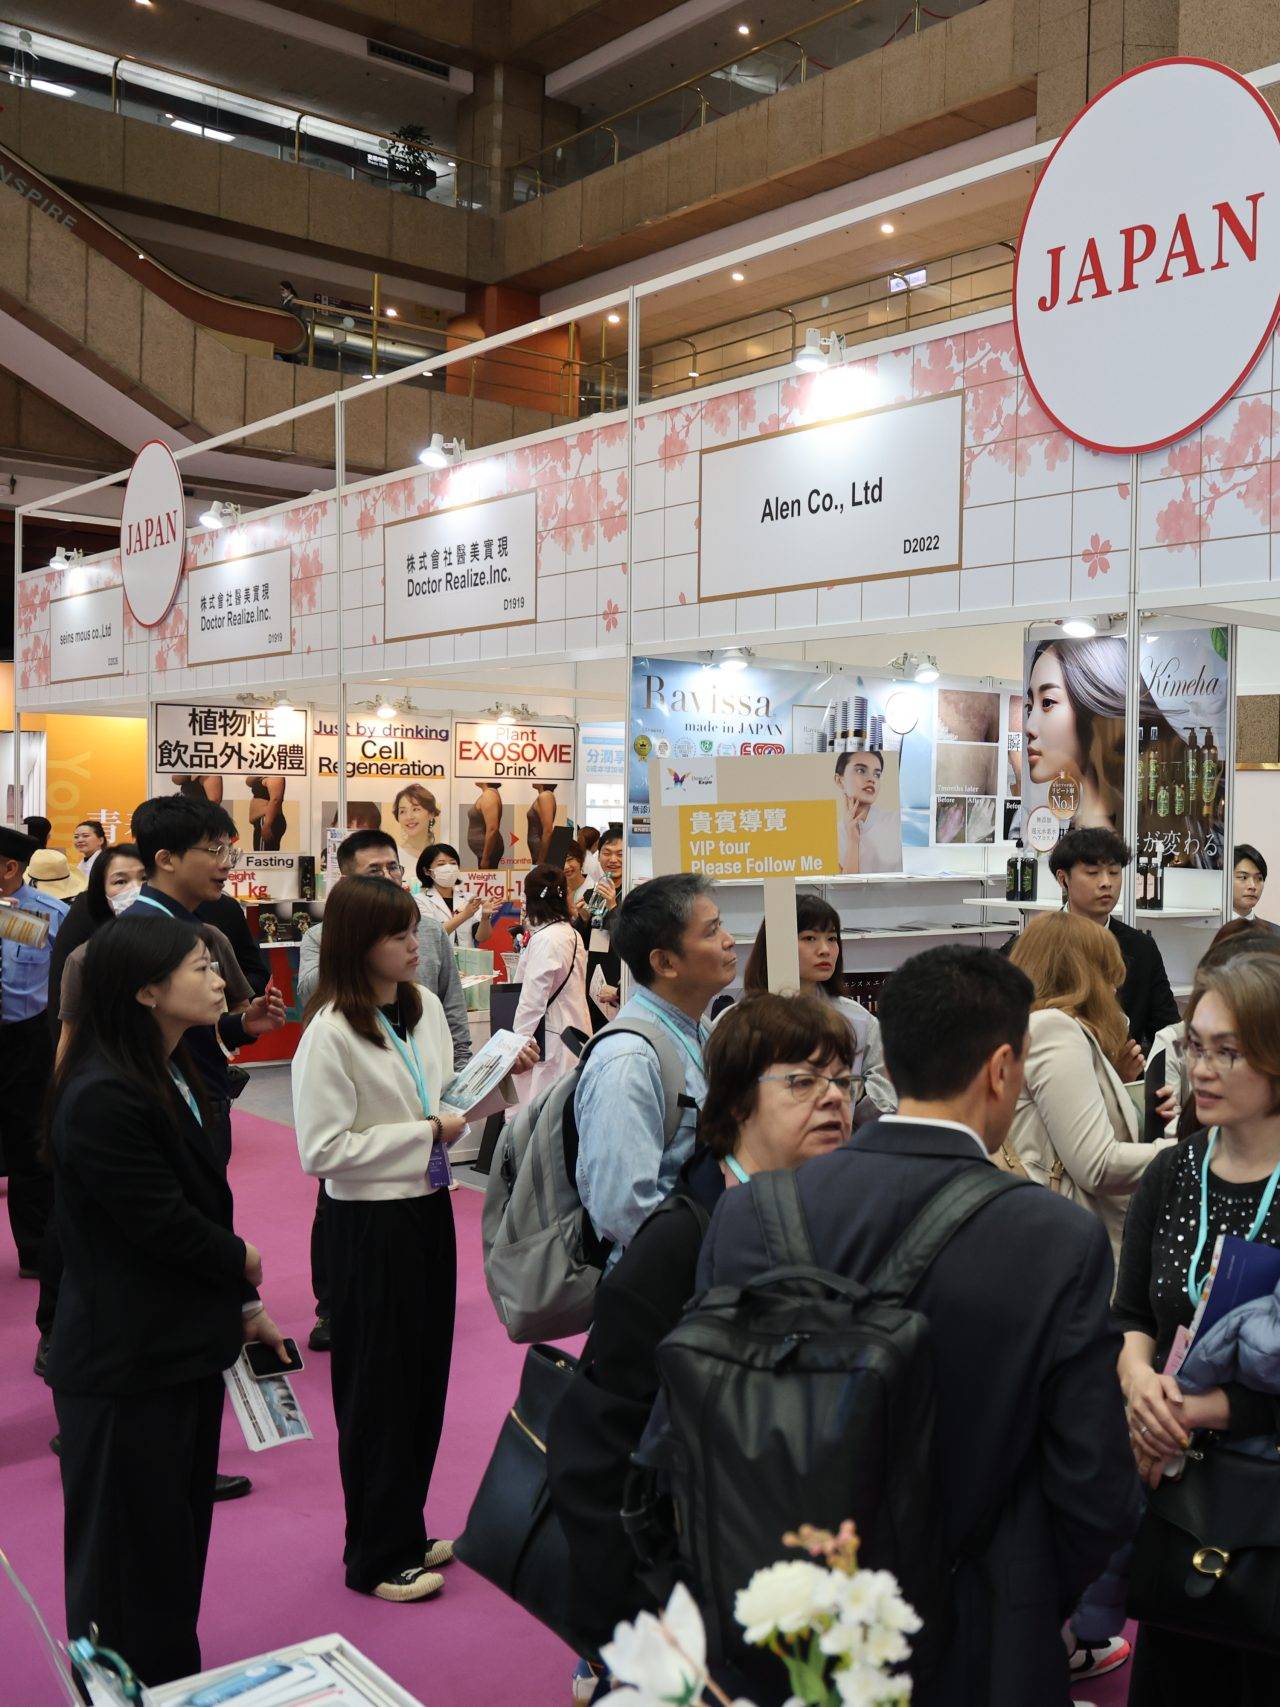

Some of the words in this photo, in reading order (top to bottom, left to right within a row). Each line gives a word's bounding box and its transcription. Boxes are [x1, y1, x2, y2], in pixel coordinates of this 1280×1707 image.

[1037, 192, 1265, 312] JAPAN
[761, 497, 800, 523] Alen
[808, 489, 843, 514] Co.,
[852, 477, 882, 506] Ltd
[126, 510, 178, 556] JAPAN
[407, 536, 508, 574] 株式會社醫美實現
[904, 535, 939, 554] D2022
[407, 577, 442, 598] Doctor
[445, 565, 511, 591] Realize.Inc.
[200, 583, 270, 612] 株式會社醫美實現
[503, 597, 525, 611] D1919
[201, 614, 225, 631] Doctor
[227, 606, 271, 627] Realize.Inc.
[60, 631, 74, 645] seins
[75, 628, 90, 642] mous
[268, 632, 283, 643] D1919
[1141, 655, 1219, 697] Kimeha
[642, 674, 777, 717] Ravissa
[188, 708, 276, 738] 植物性
[313, 720, 350, 736] Just
[356, 722, 376, 738] by
[382, 724, 449, 741] drinking
[685, 721, 718, 732] made
[722, 721, 734, 733] in
[738, 722, 783, 735] JAPAN
[496, 726, 537, 742] Plant
[158, 740, 304, 771] 飲品外泌體
[361, 740, 404, 760] Cell
[459, 741, 572, 764] EXOSOME
[319, 757, 445, 778] Regeneration
[494, 762, 536, 777] Drink
[1051, 795, 1075, 810] No.1
[690, 808, 787, 834] 貴賓導覽
[690, 840, 715, 856] VIP
[719, 841, 751, 855] tour
[1136, 830, 1217, 856] が変わる
[246, 856, 294, 868] Fasting
[691, 860, 742, 876] Please
[746, 856, 796, 873] Follow
[800, 855, 823, 871] Me
[228, 871, 256, 881] eight
[468, 873, 496, 881] Weight
